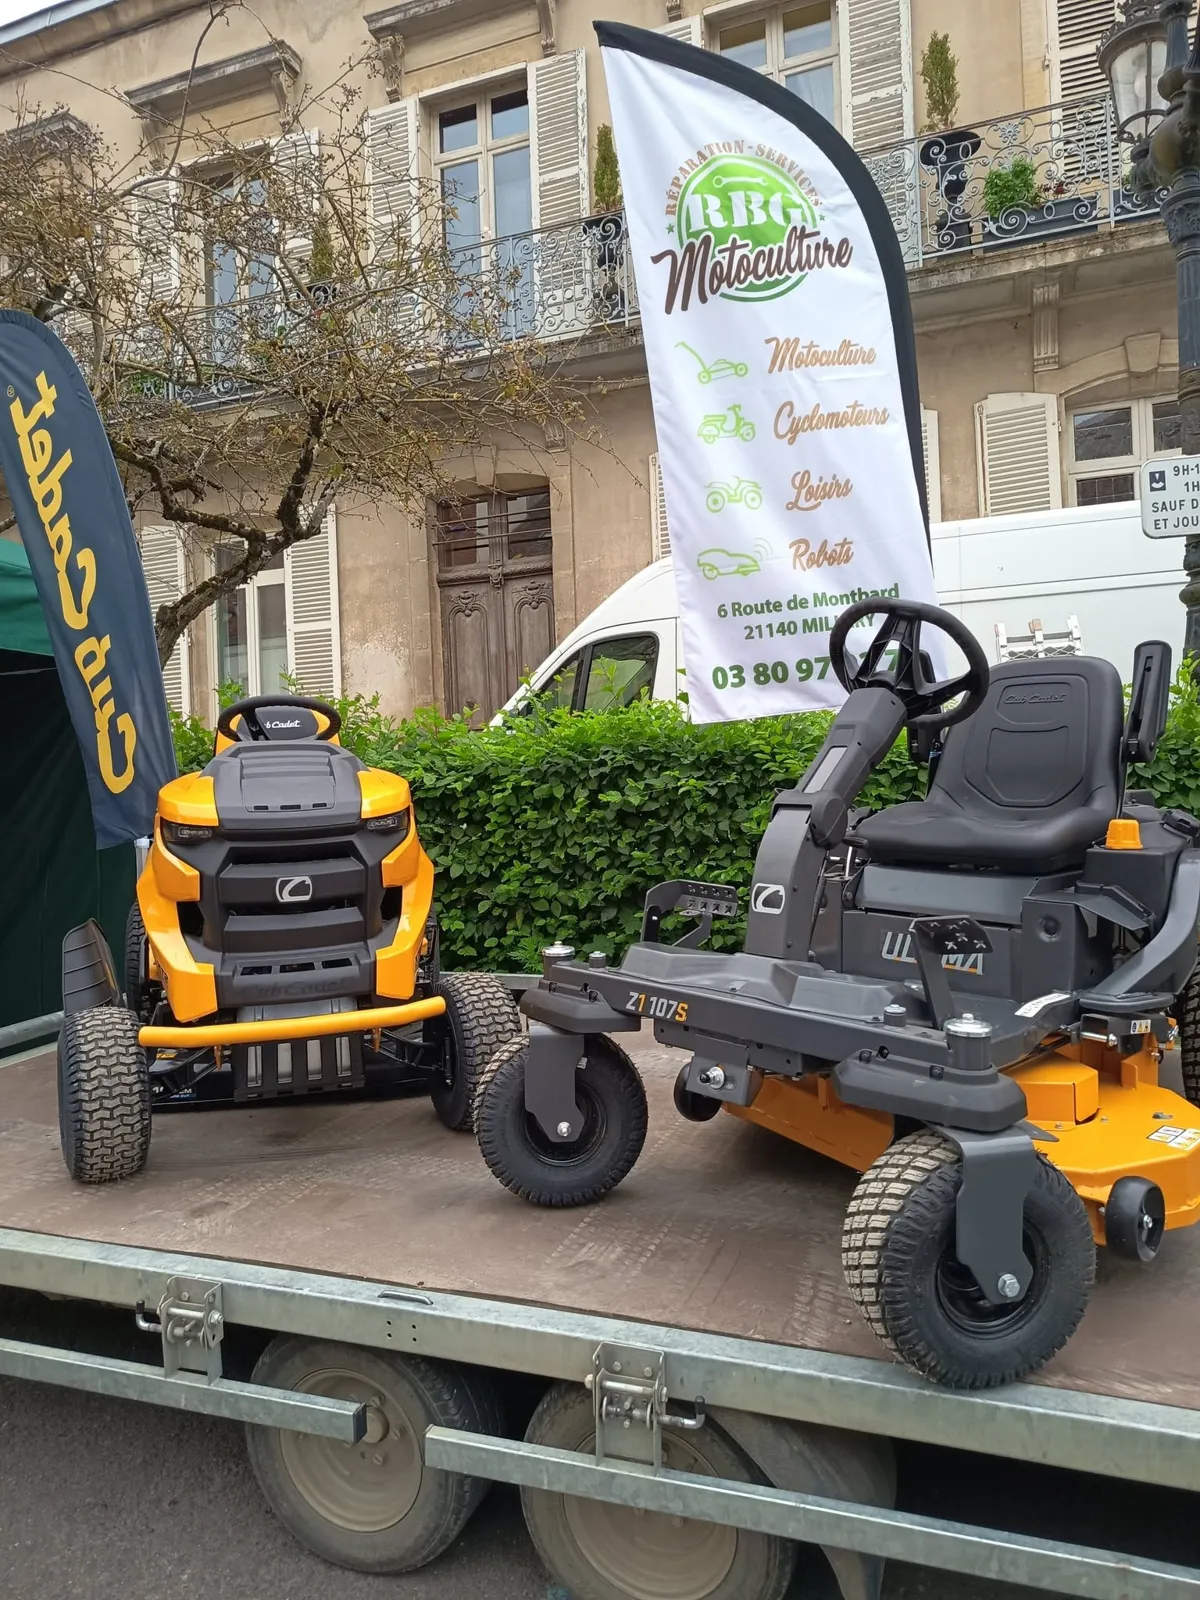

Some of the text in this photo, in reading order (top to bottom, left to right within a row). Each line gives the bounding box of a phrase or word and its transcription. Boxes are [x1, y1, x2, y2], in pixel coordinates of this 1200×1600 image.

[755, 143, 823, 207] SERVICES
[686, 190, 804, 233] RBG
[651, 225, 853, 315] Motoculture
[764, 336, 876, 374] Motoculture
[773, 400, 890, 446] Cyclomoteurs
[785, 470, 853, 512] Loisirs
[1151, 499, 1186, 513] SAUF
[1154, 517, 1169, 530] ET
[788, 537, 854, 572] Robots
[717, 603, 728, 619] 6
[731, 594, 783, 618] Route
[786, 593, 809, 612] de
[744, 620, 798, 640] 21140
[712, 664, 746, 690] 03
[753, 660, 789, 685] 80
[795, 656, 832, 682] 97
[271, 719, 301, 729] Cadet
[625, 991, 689, 1022] Z1 107S
